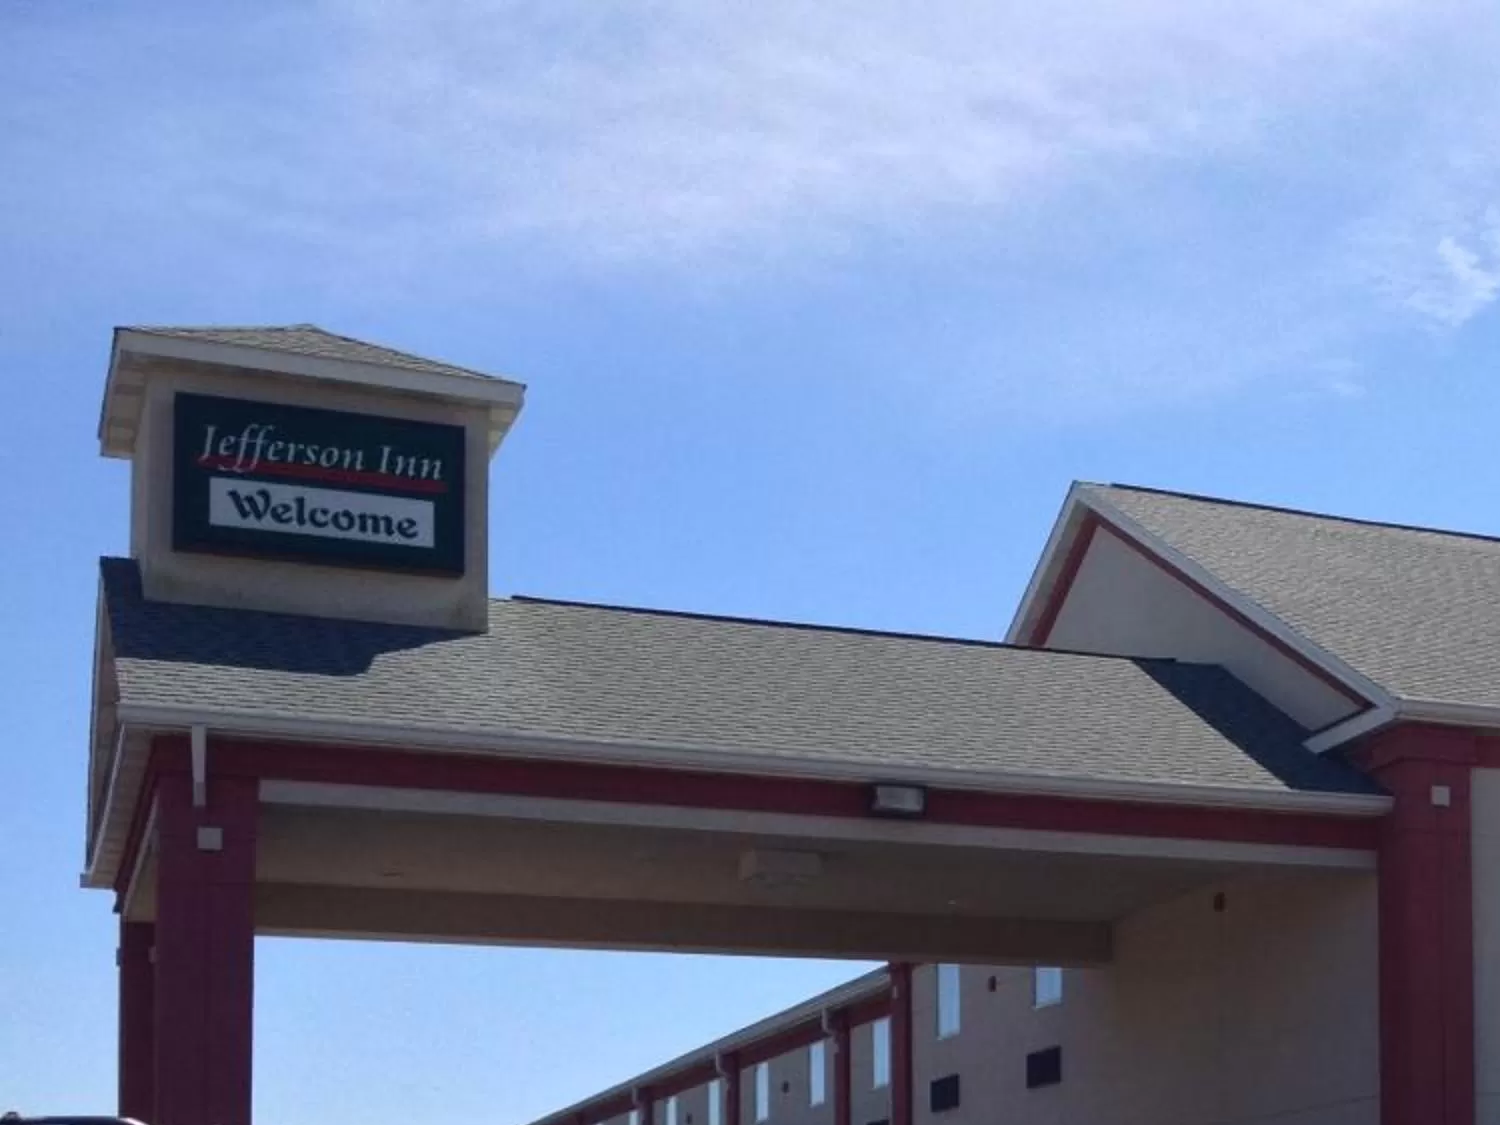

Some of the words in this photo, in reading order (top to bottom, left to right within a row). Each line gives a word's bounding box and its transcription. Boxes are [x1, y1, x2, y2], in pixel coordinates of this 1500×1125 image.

[199, 424, 365, 473] Jefferson
[379, 445, 446, 481] Inn
[228, 488, 418, 539] Welcome
